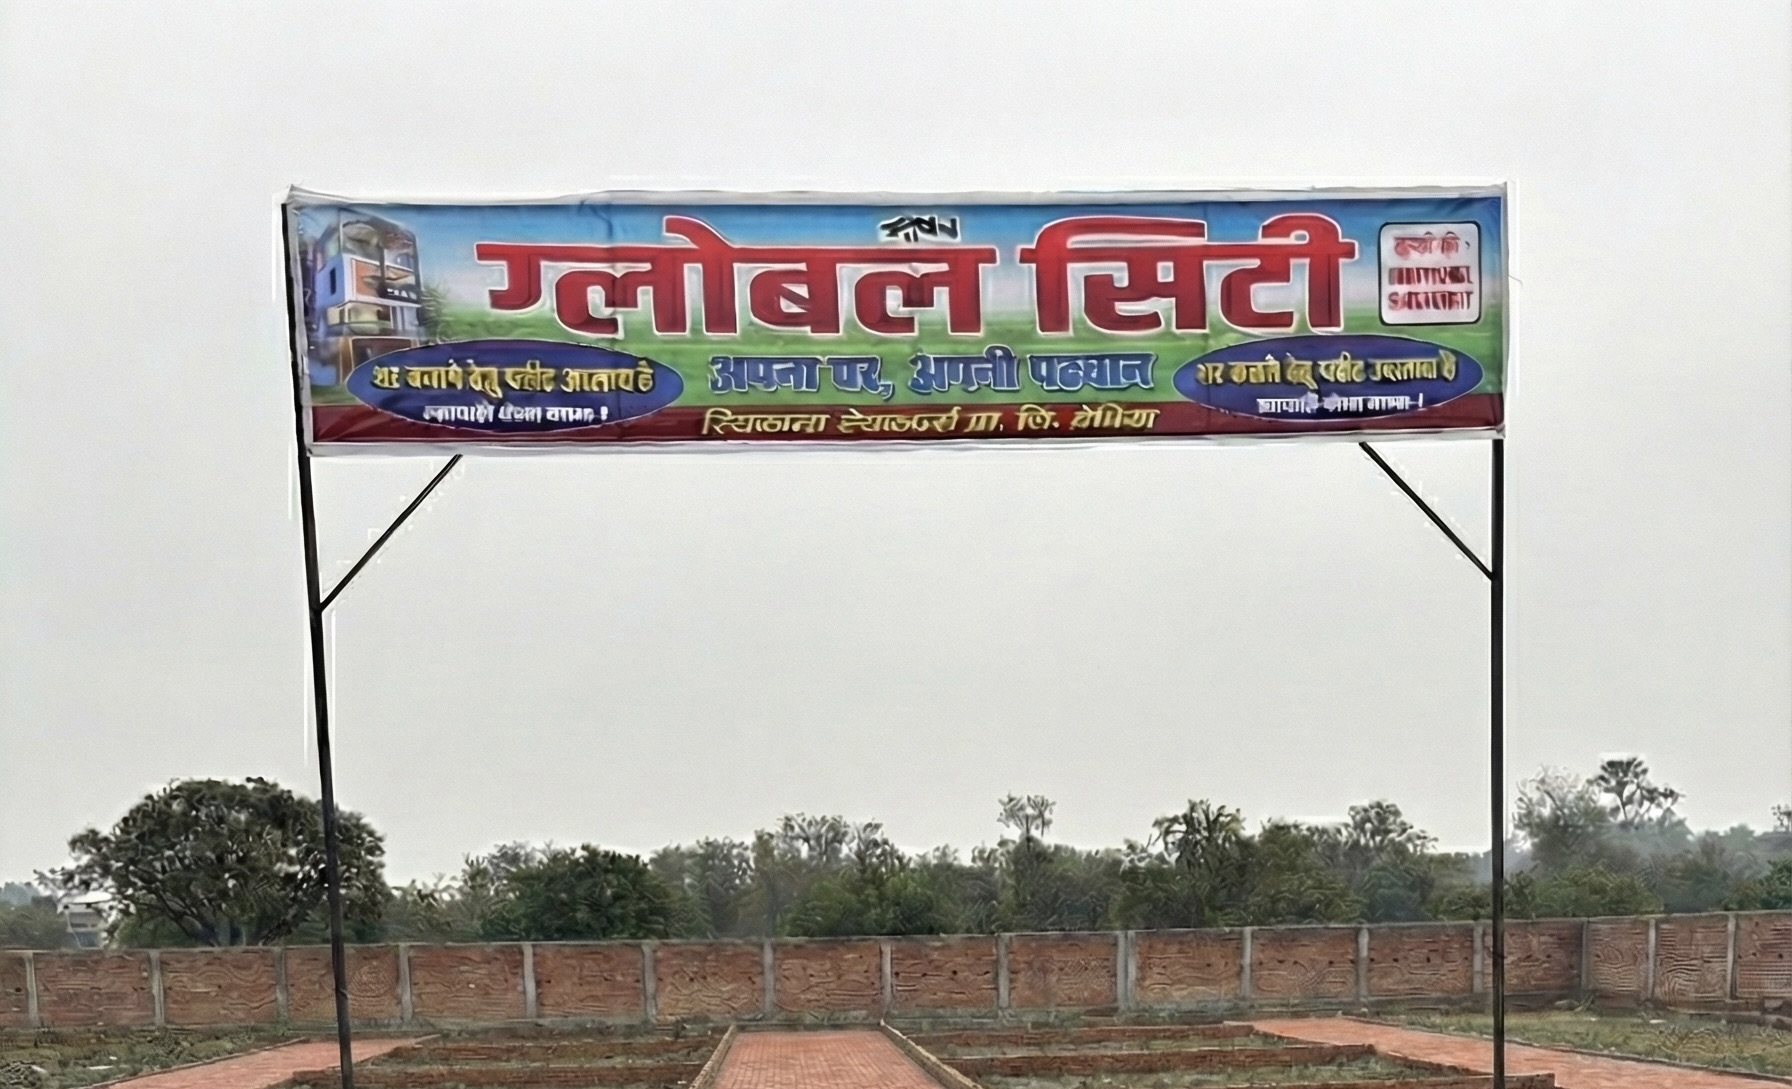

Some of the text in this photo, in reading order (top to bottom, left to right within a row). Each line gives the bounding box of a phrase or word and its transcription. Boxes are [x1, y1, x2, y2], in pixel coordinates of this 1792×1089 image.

[475, 213, 1360, 338] ग्लोबल सिटी
[708, 355, 824, 394] अपना
